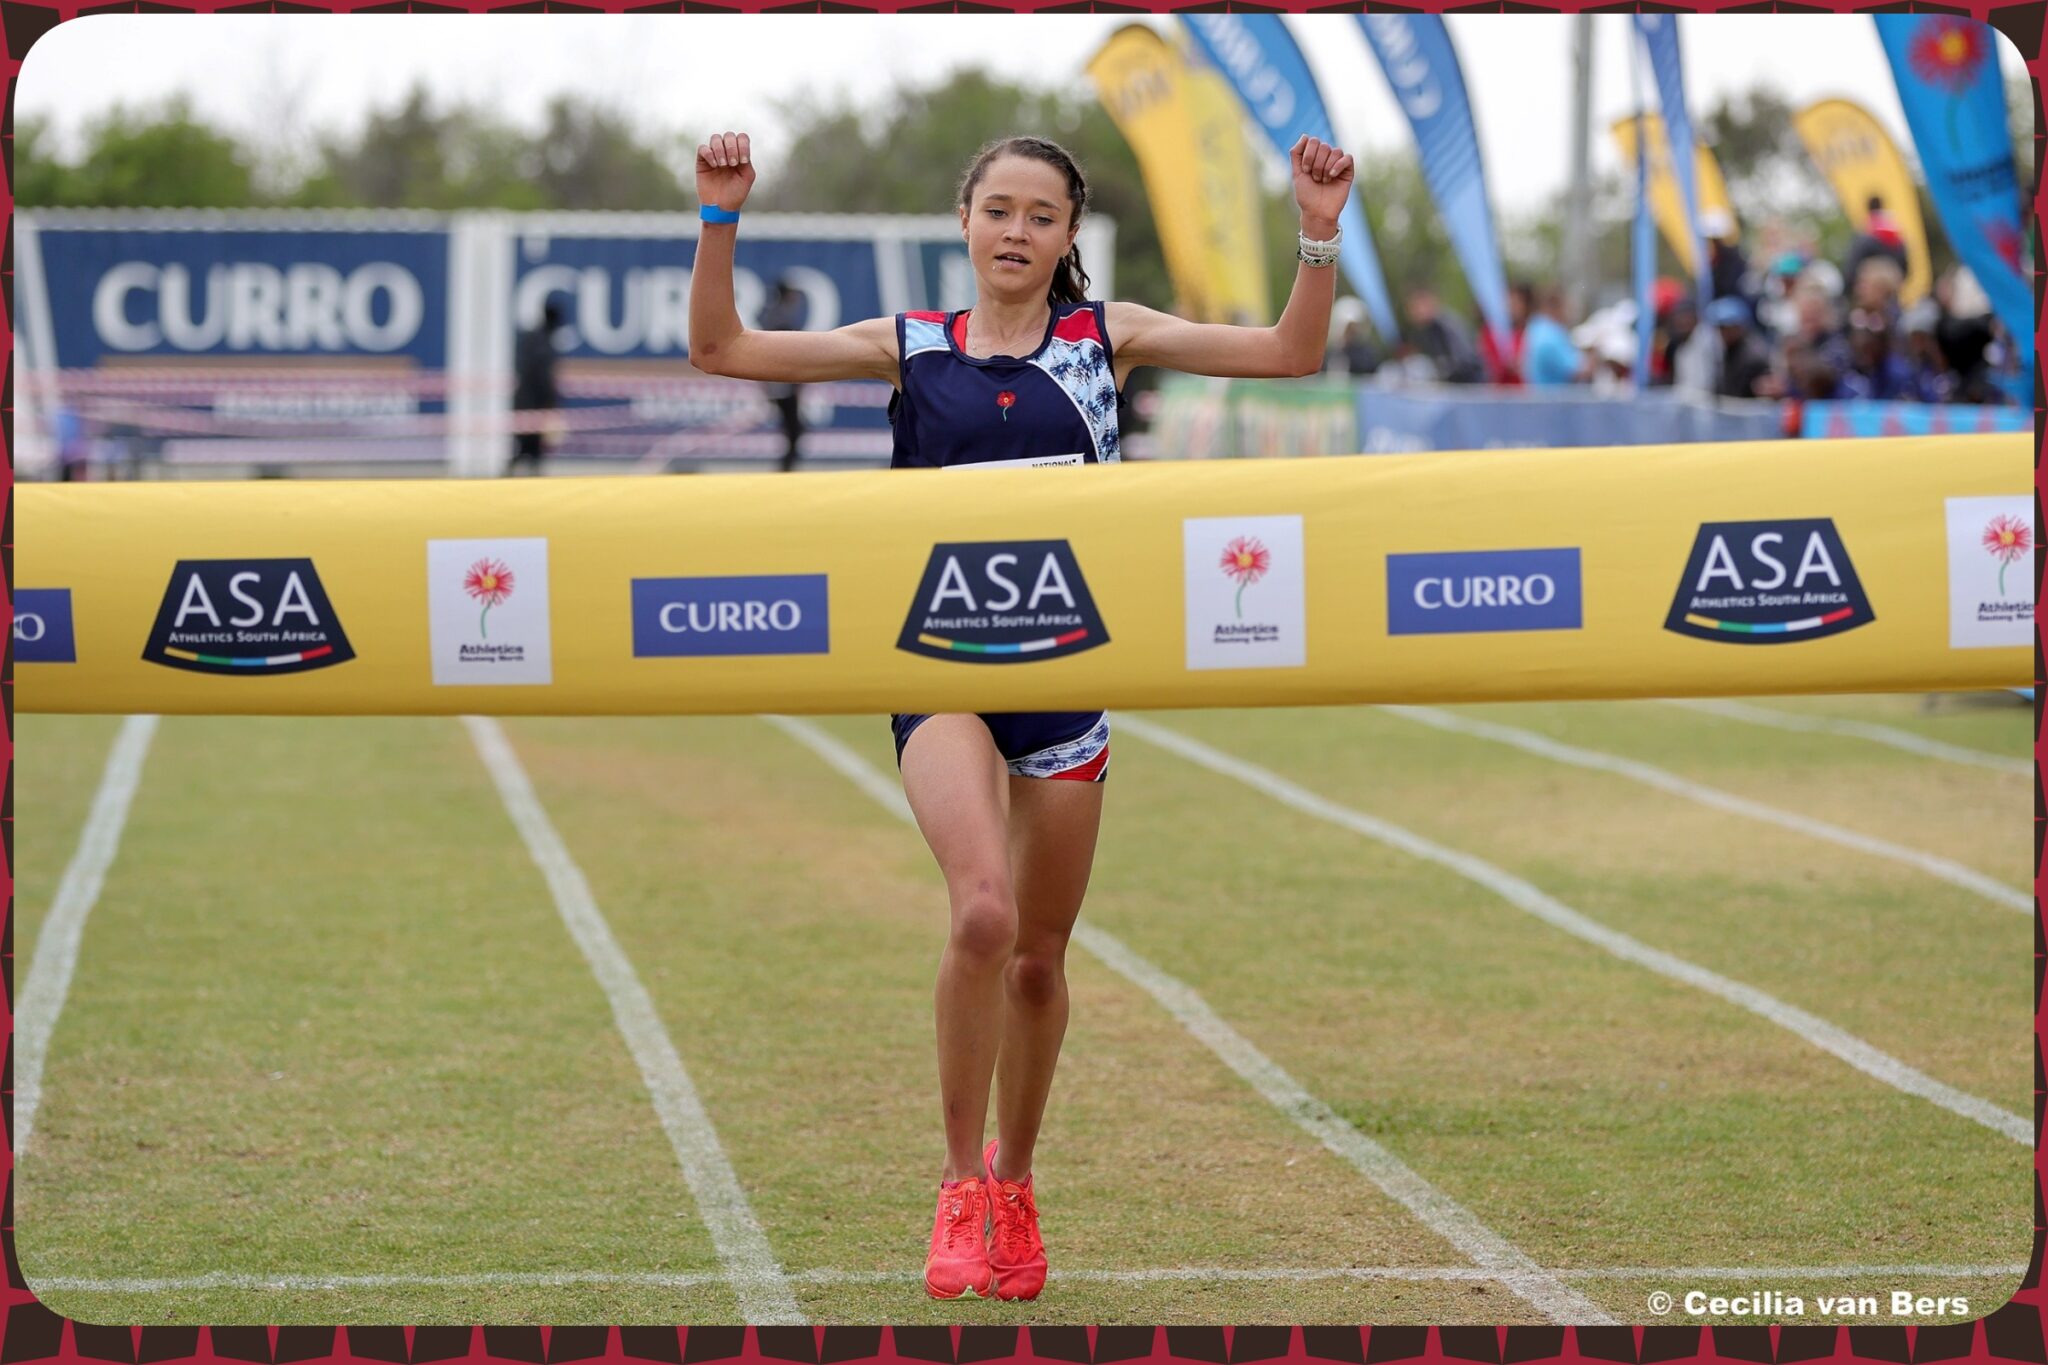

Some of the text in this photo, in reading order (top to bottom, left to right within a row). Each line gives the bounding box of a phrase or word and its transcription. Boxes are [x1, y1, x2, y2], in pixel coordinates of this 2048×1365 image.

[93, 261, 424, 352] CURRO
[1696, 531, 1841, 592] ASA
[173, 570, 320, 628] ASA
[929, 552, 1076, 612] ASA
[1413, 574, 1555, 609] CURRO
[659, 600, 801, 633] CURRO
[1979, 602, 2034, 613] Athletic
[1214, 624, 1279, 636] Athletics
[459, 644, 524, 655] Athletics
